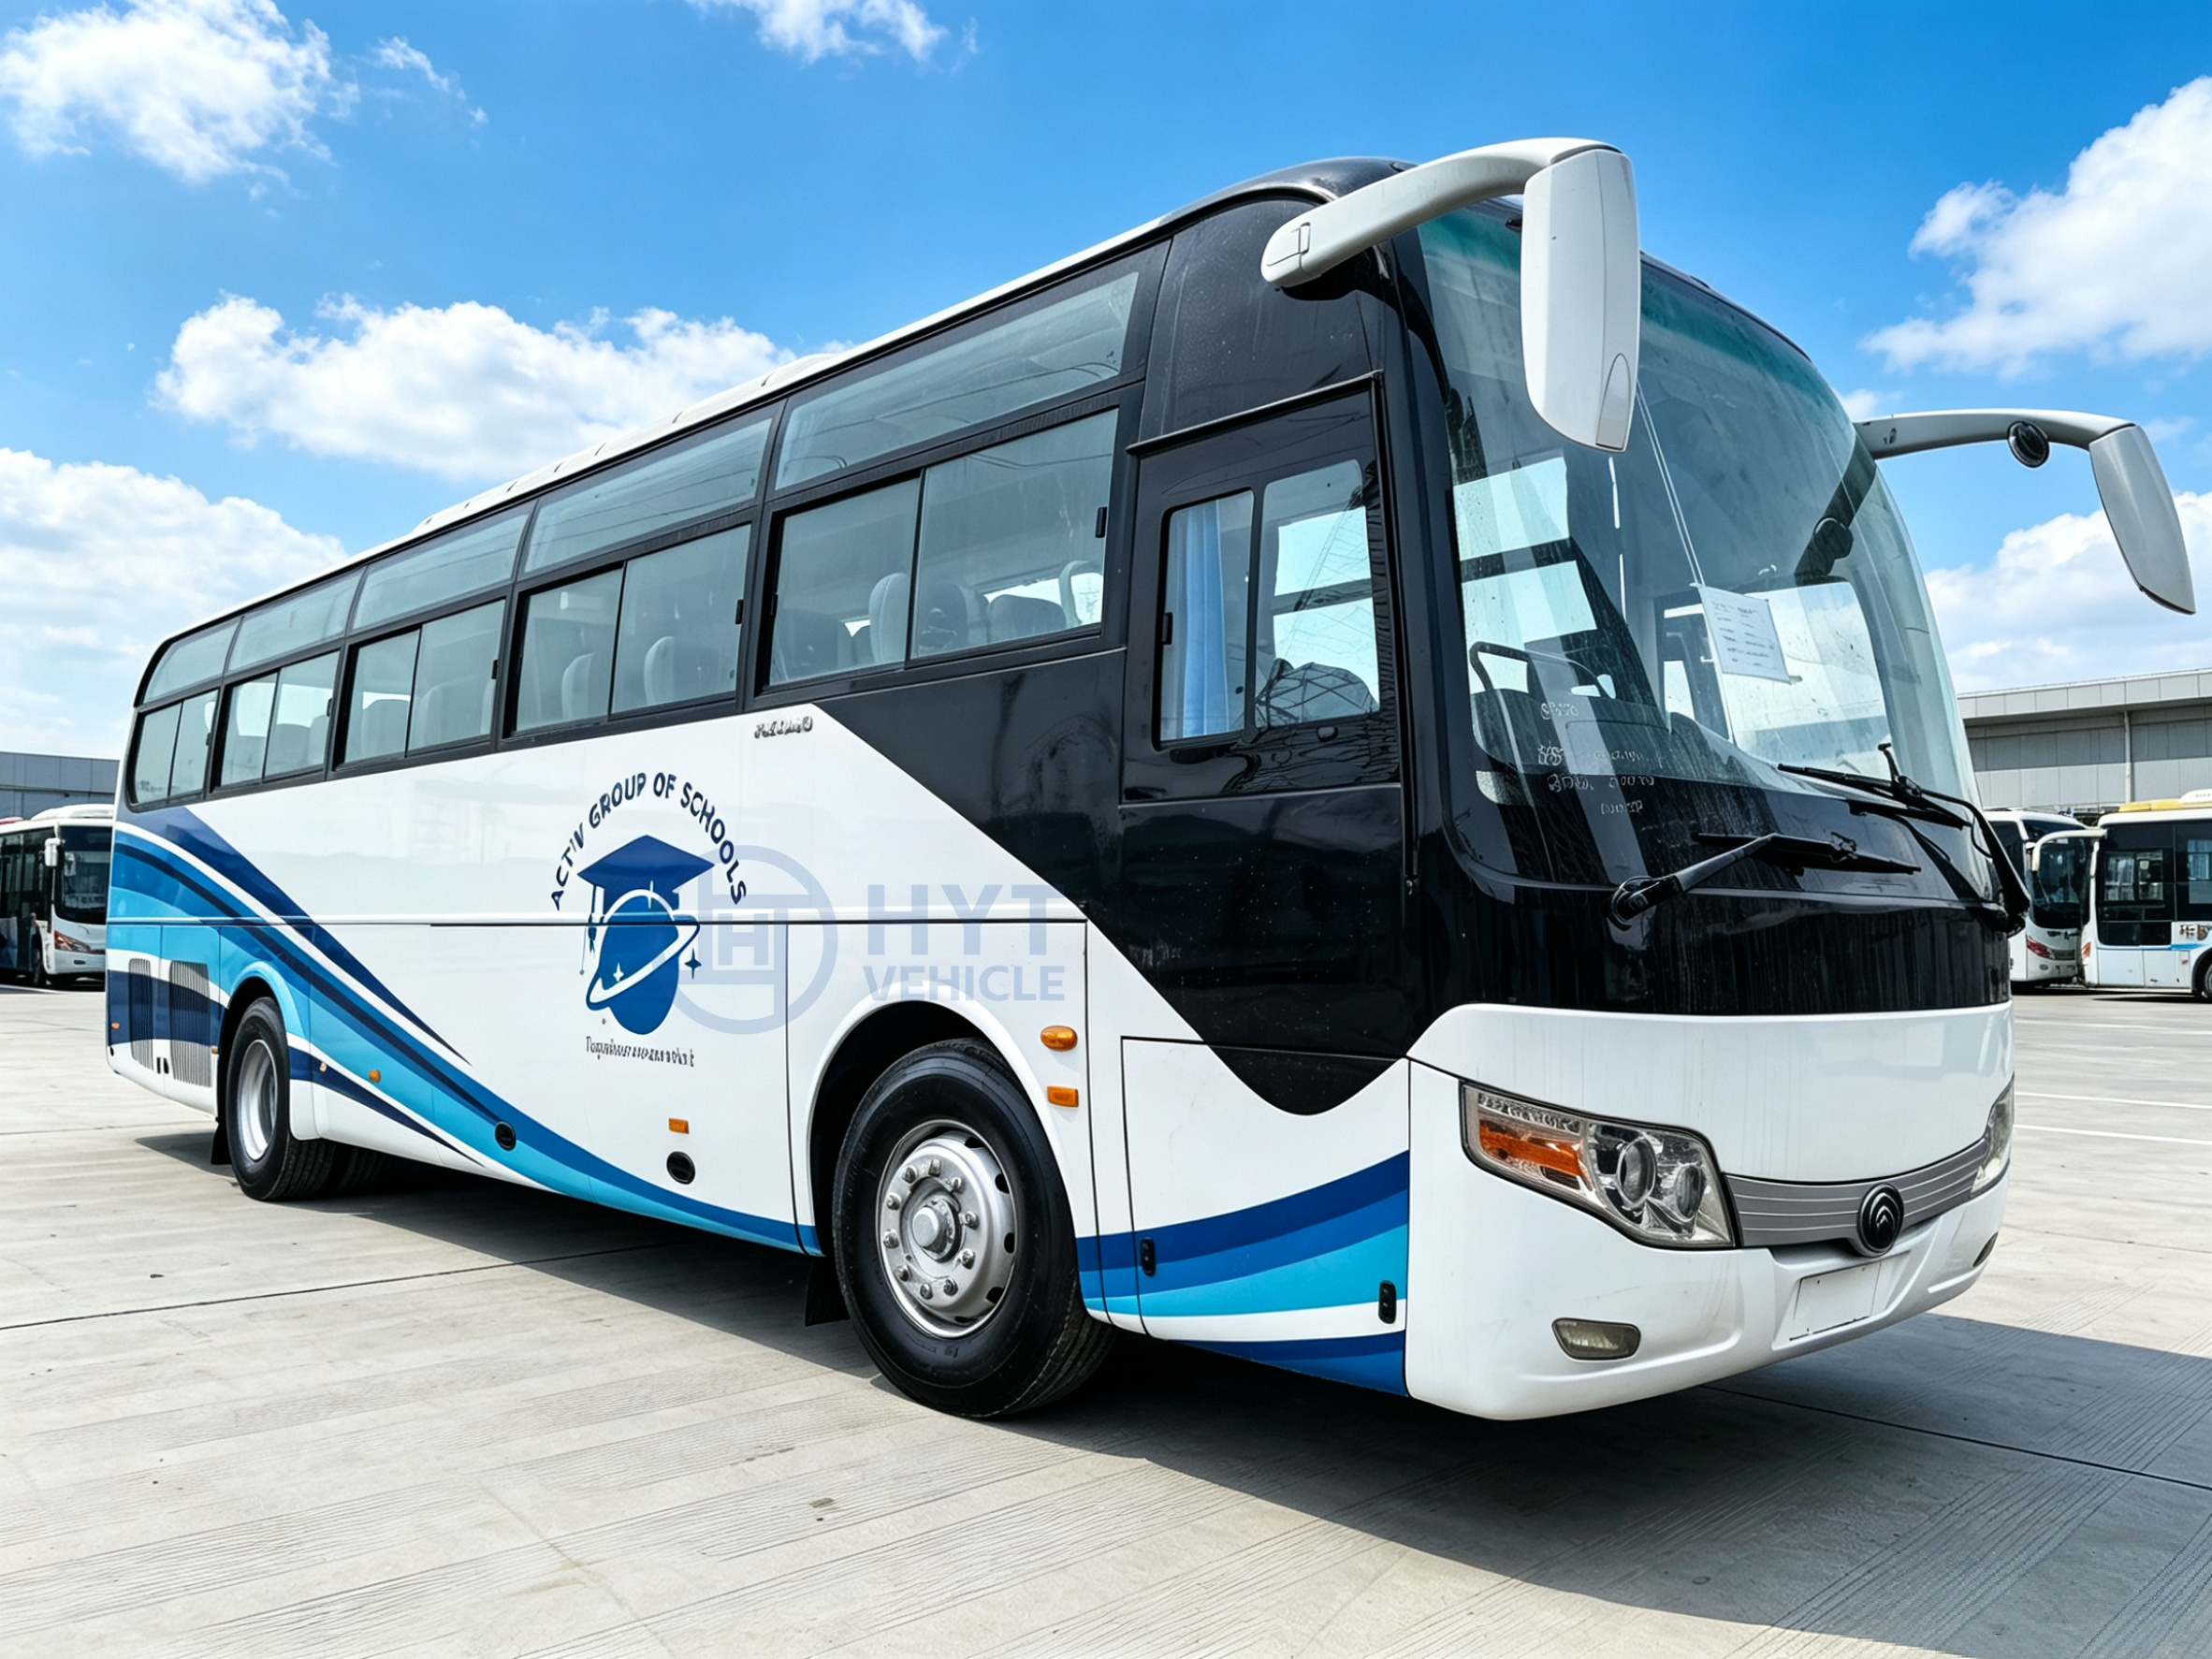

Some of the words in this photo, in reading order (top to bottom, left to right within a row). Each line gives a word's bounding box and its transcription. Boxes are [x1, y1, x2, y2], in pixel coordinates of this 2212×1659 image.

[589, 772, 647, 829] GROUP
[653, 772, 677, 799] OF
[680, 781, 747, 905] SCHOOLS
